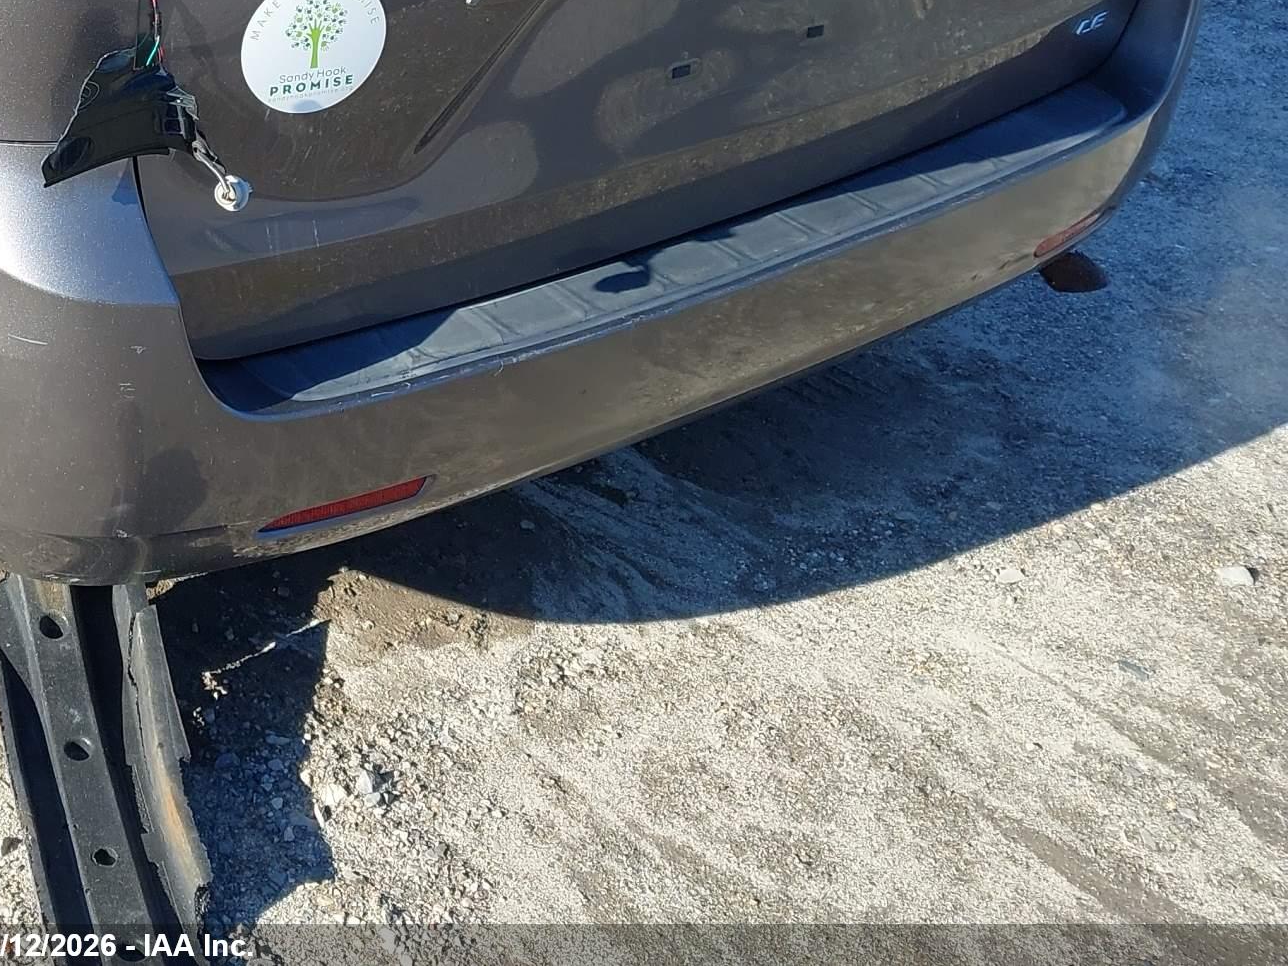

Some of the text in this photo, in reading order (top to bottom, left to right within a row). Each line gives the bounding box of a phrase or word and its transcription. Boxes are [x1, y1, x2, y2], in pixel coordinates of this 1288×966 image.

[250, 0, 281, 41] MAKE
[269, 74, 354, 97] PROMISE
[279, 66, 347, 84] Sandy Hook
